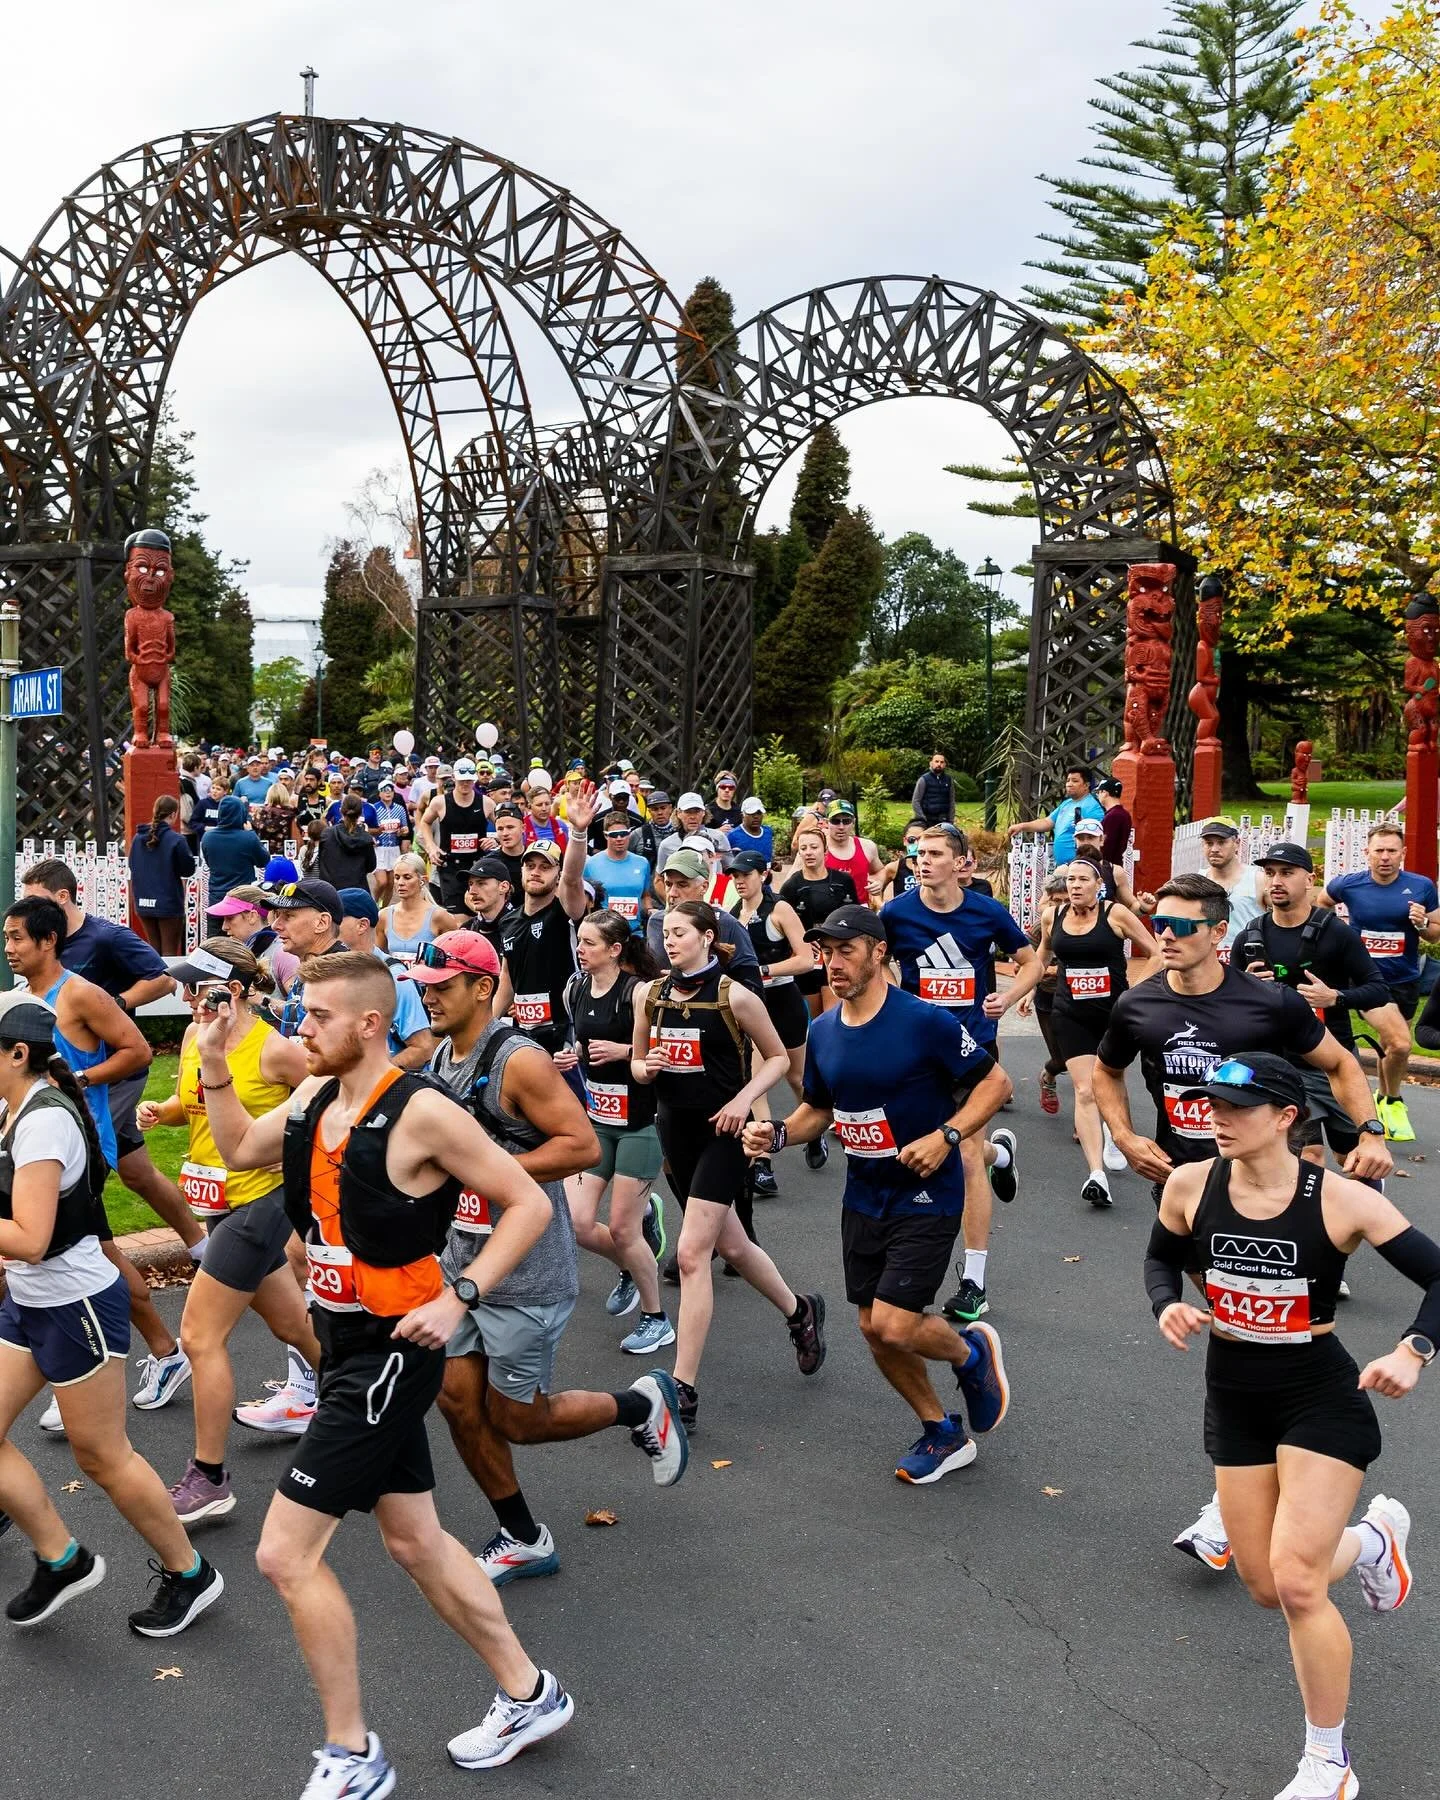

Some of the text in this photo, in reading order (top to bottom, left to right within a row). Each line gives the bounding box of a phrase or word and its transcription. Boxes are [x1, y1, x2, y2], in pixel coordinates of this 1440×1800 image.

[12, 673, 58, 714] ARAWA ST
[1365, 939, 1399, 951] 5225
[927, 980, 966, 995] 4751
[1071, 977, 1105, 991] 4684
[841, 1125, 884, 1144] 4646
[184, 1178, 219, 1202] 4970
[1303, 1173, 1317, 1198] LSKD
[1213, 1260, 1296, 1277] Gold Coast Run Co.
[1219, 1292, 1296, 1324] 4427
[1228, 1317, 1287, 1332] LARA THORNTON
[1254, 1334, 1292, 1342] MARATHON
